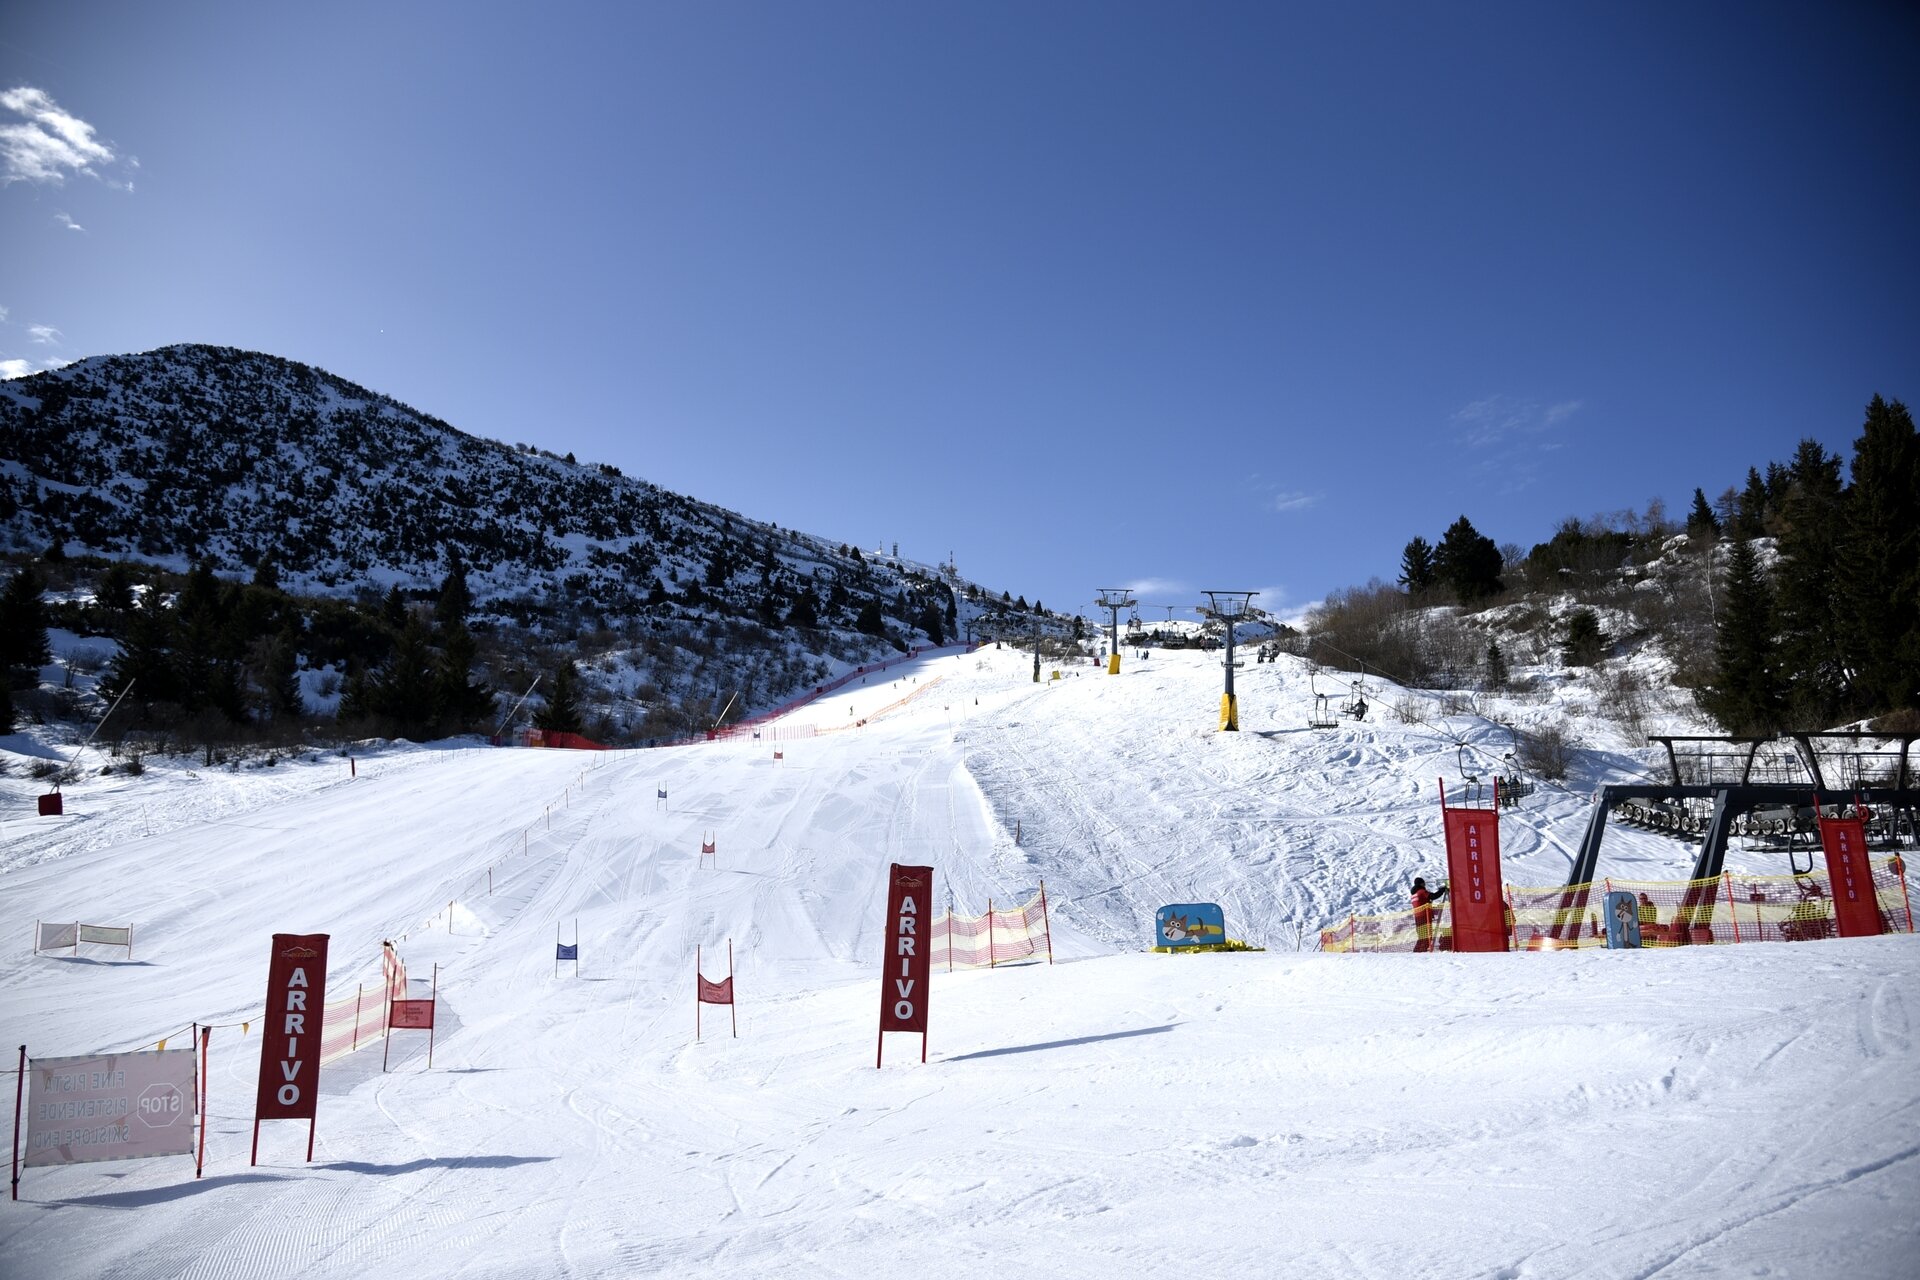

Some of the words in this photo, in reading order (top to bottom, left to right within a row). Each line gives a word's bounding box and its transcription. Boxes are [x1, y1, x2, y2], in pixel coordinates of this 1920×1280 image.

[1469, 825, 1481, 900] ARRIVO
[1839, 831, 1855, 899] ARRIVO
[894, 896, 917, 1020] ARRIVO
[277, 967, 308, 1106] ARRIVO
